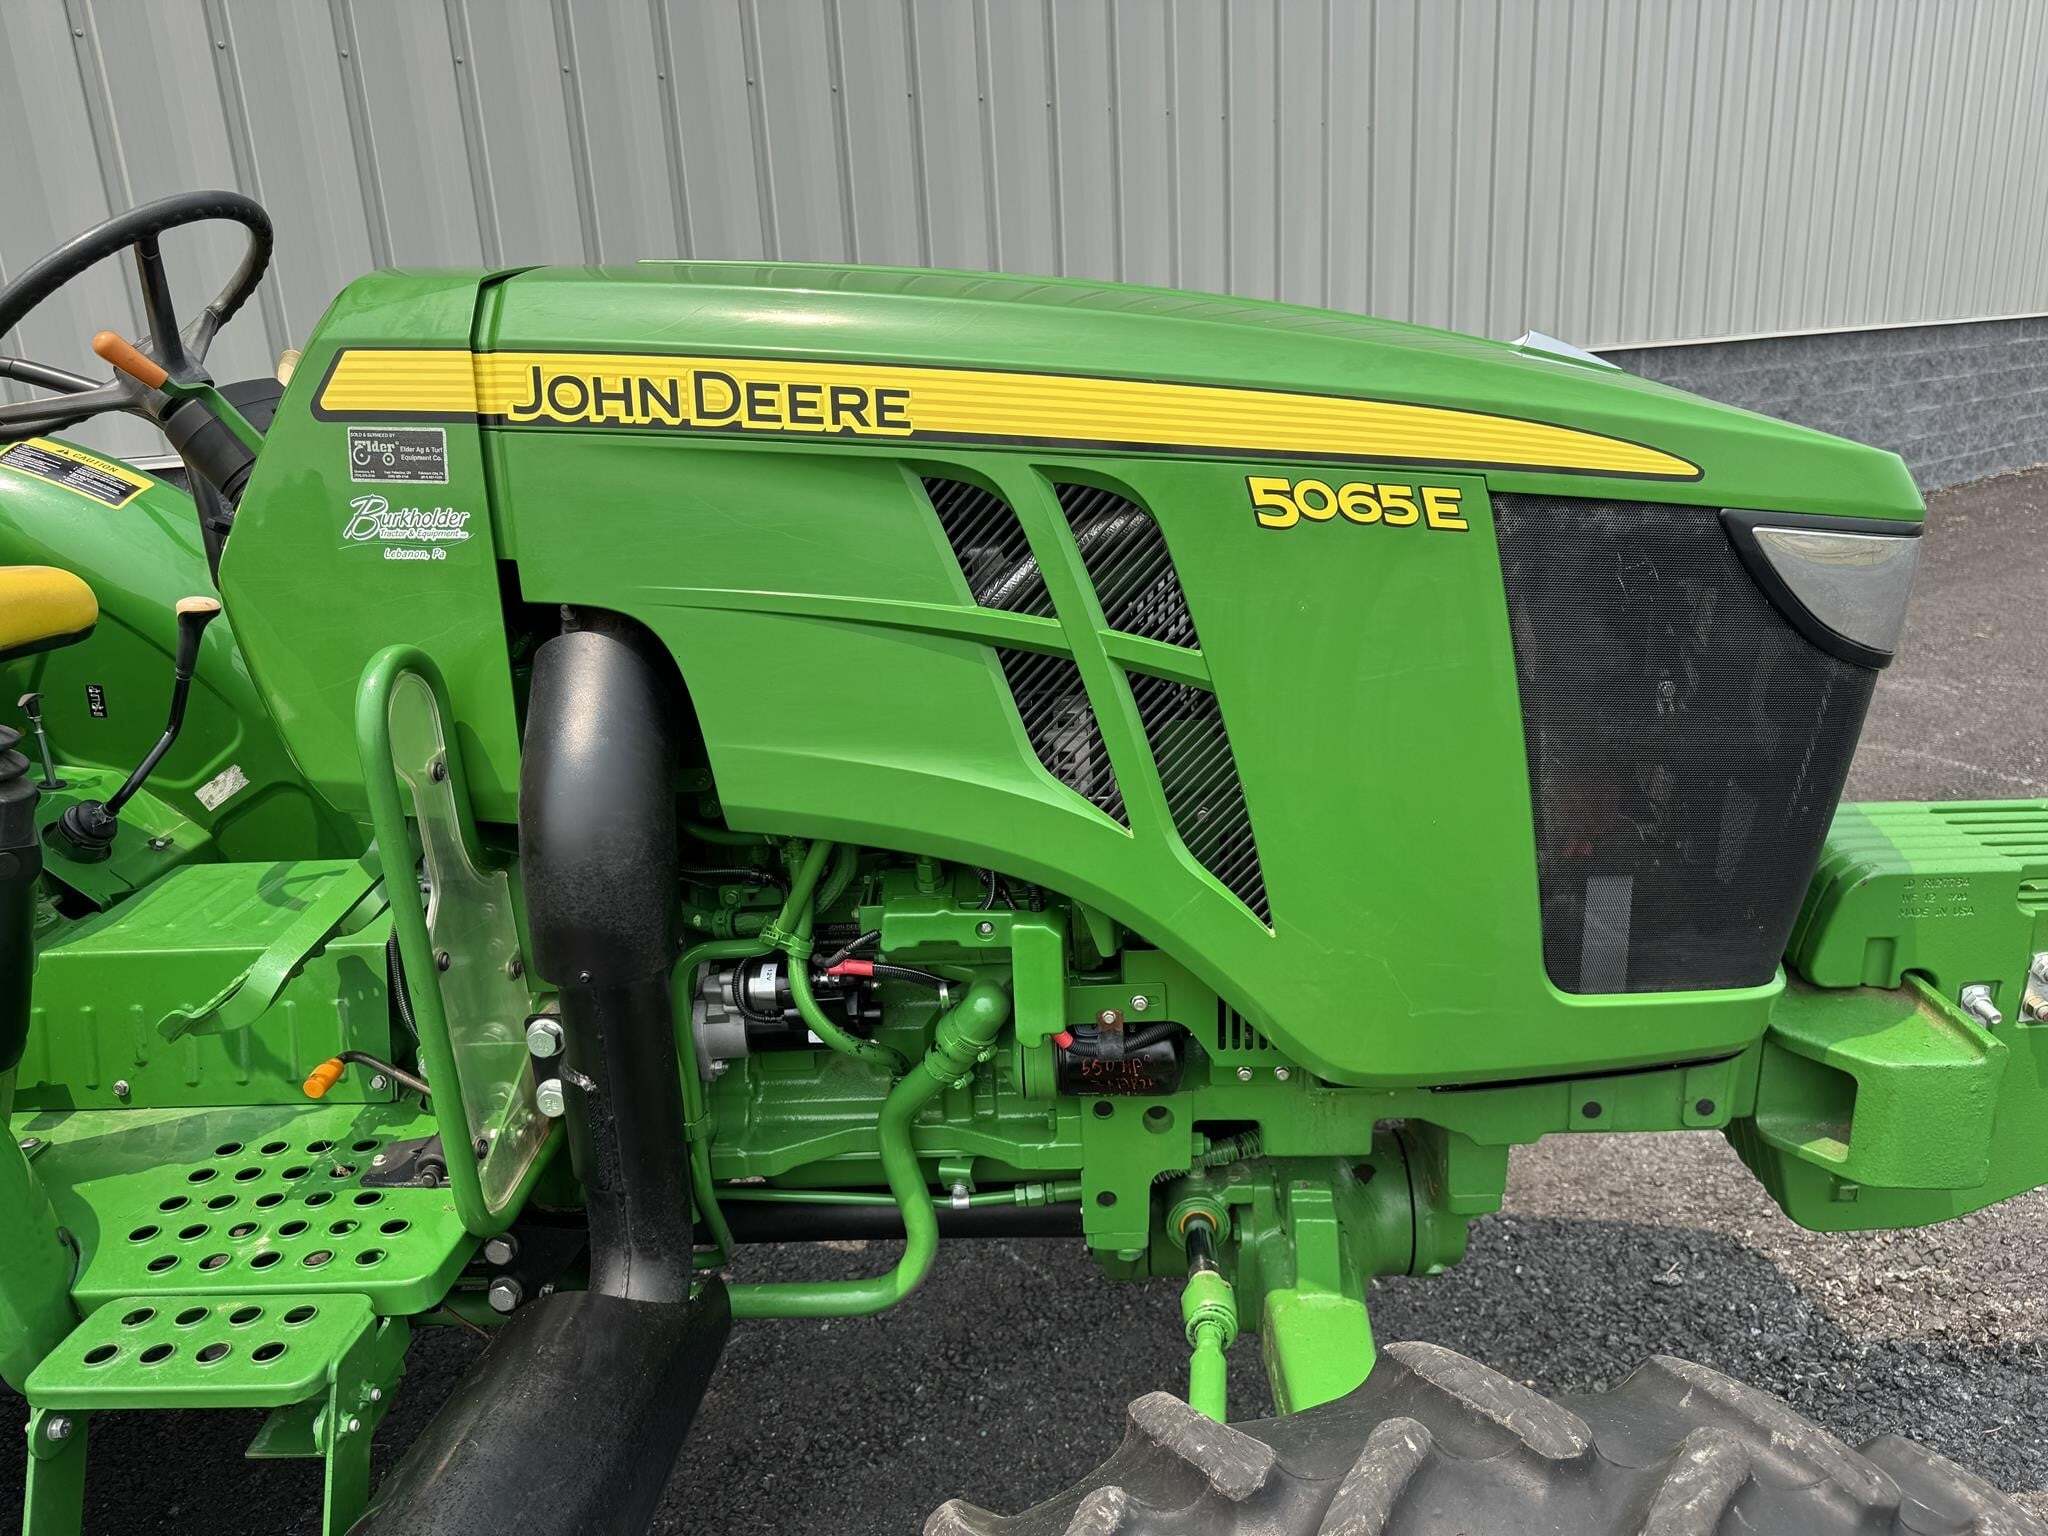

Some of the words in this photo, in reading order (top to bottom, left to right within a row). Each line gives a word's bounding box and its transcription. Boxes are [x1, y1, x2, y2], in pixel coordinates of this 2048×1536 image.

[511, 365, 682, 421] JOHN
[690, 369, 913, 432] DEERE
[416, 446, 424, 454] Ag
[73, 453, 119, 473] CAUTION
[401, 454, 431, 462] Equipment
[343, 493, 471, 541] Burkholder
[380, 528, 407, 538] Tractor
[408, 528, 415, 538] &
[416, 528, 459, 541] Equipment
[384, 547, 430, 560] Lebanon,
[432, 547, 447, 560] Pa
